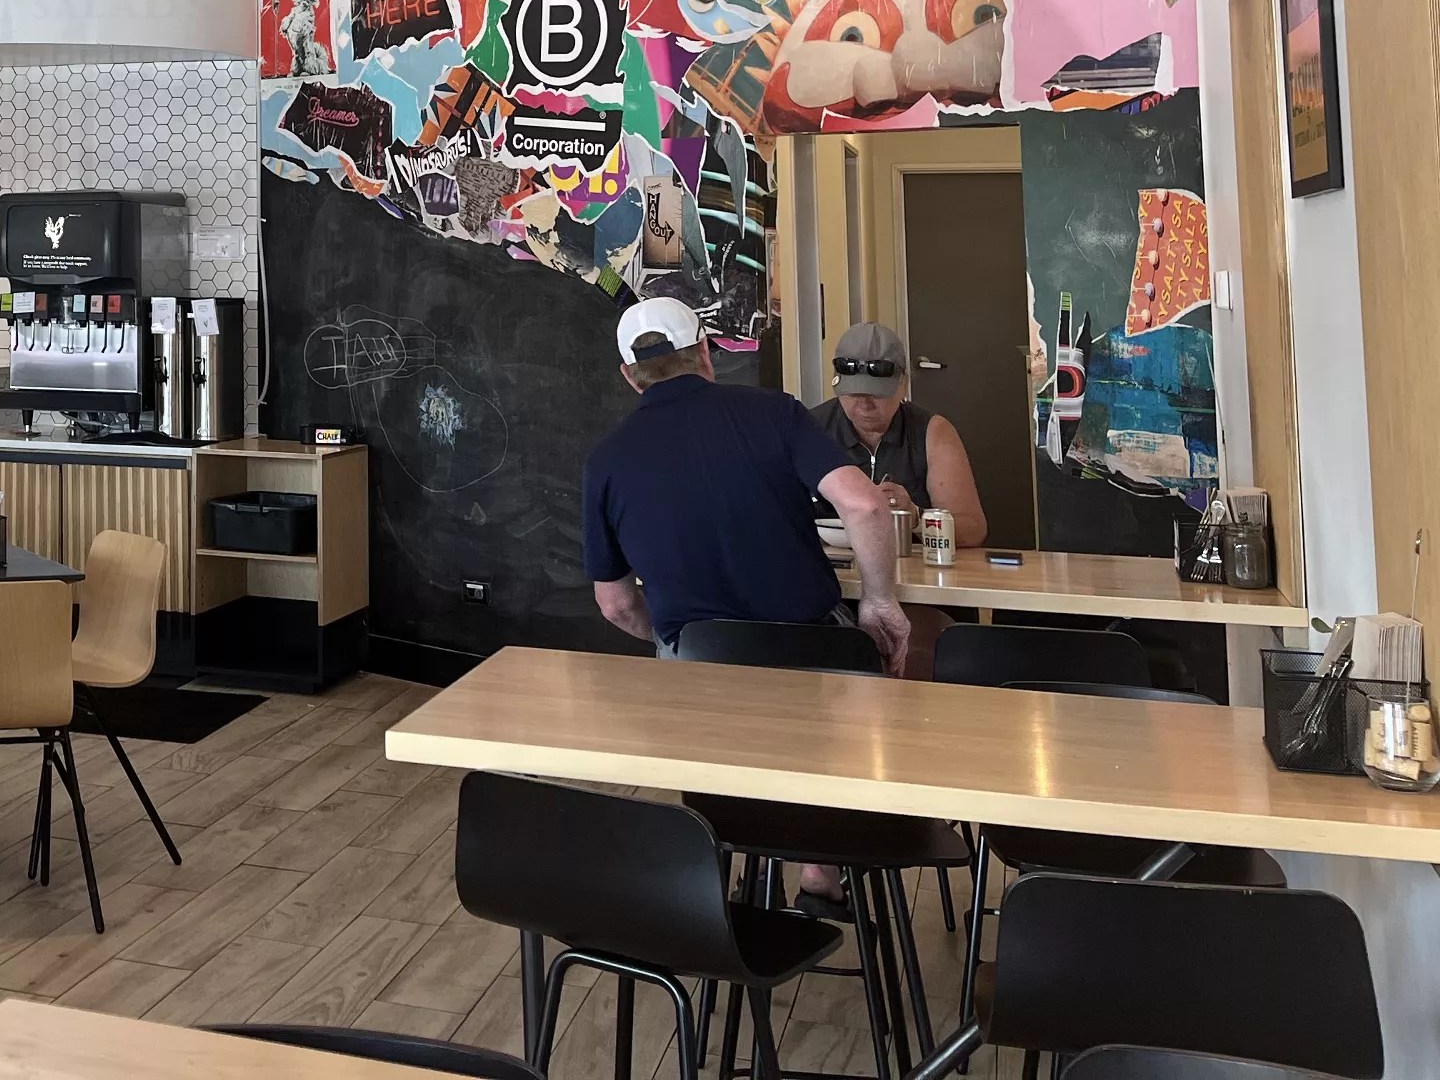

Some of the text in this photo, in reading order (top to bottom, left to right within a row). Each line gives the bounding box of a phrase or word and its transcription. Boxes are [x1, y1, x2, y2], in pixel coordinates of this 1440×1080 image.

[308, 97, 359, 127] Dreamer
[512, 133, 605, 157] Corporation
[425, 174, 458, 205] LOVE
[648, 193, 672, 238] HANGOUT
[1162, 229, 1180, 304] SALTY
[923, 537, 950, 549] AGER
